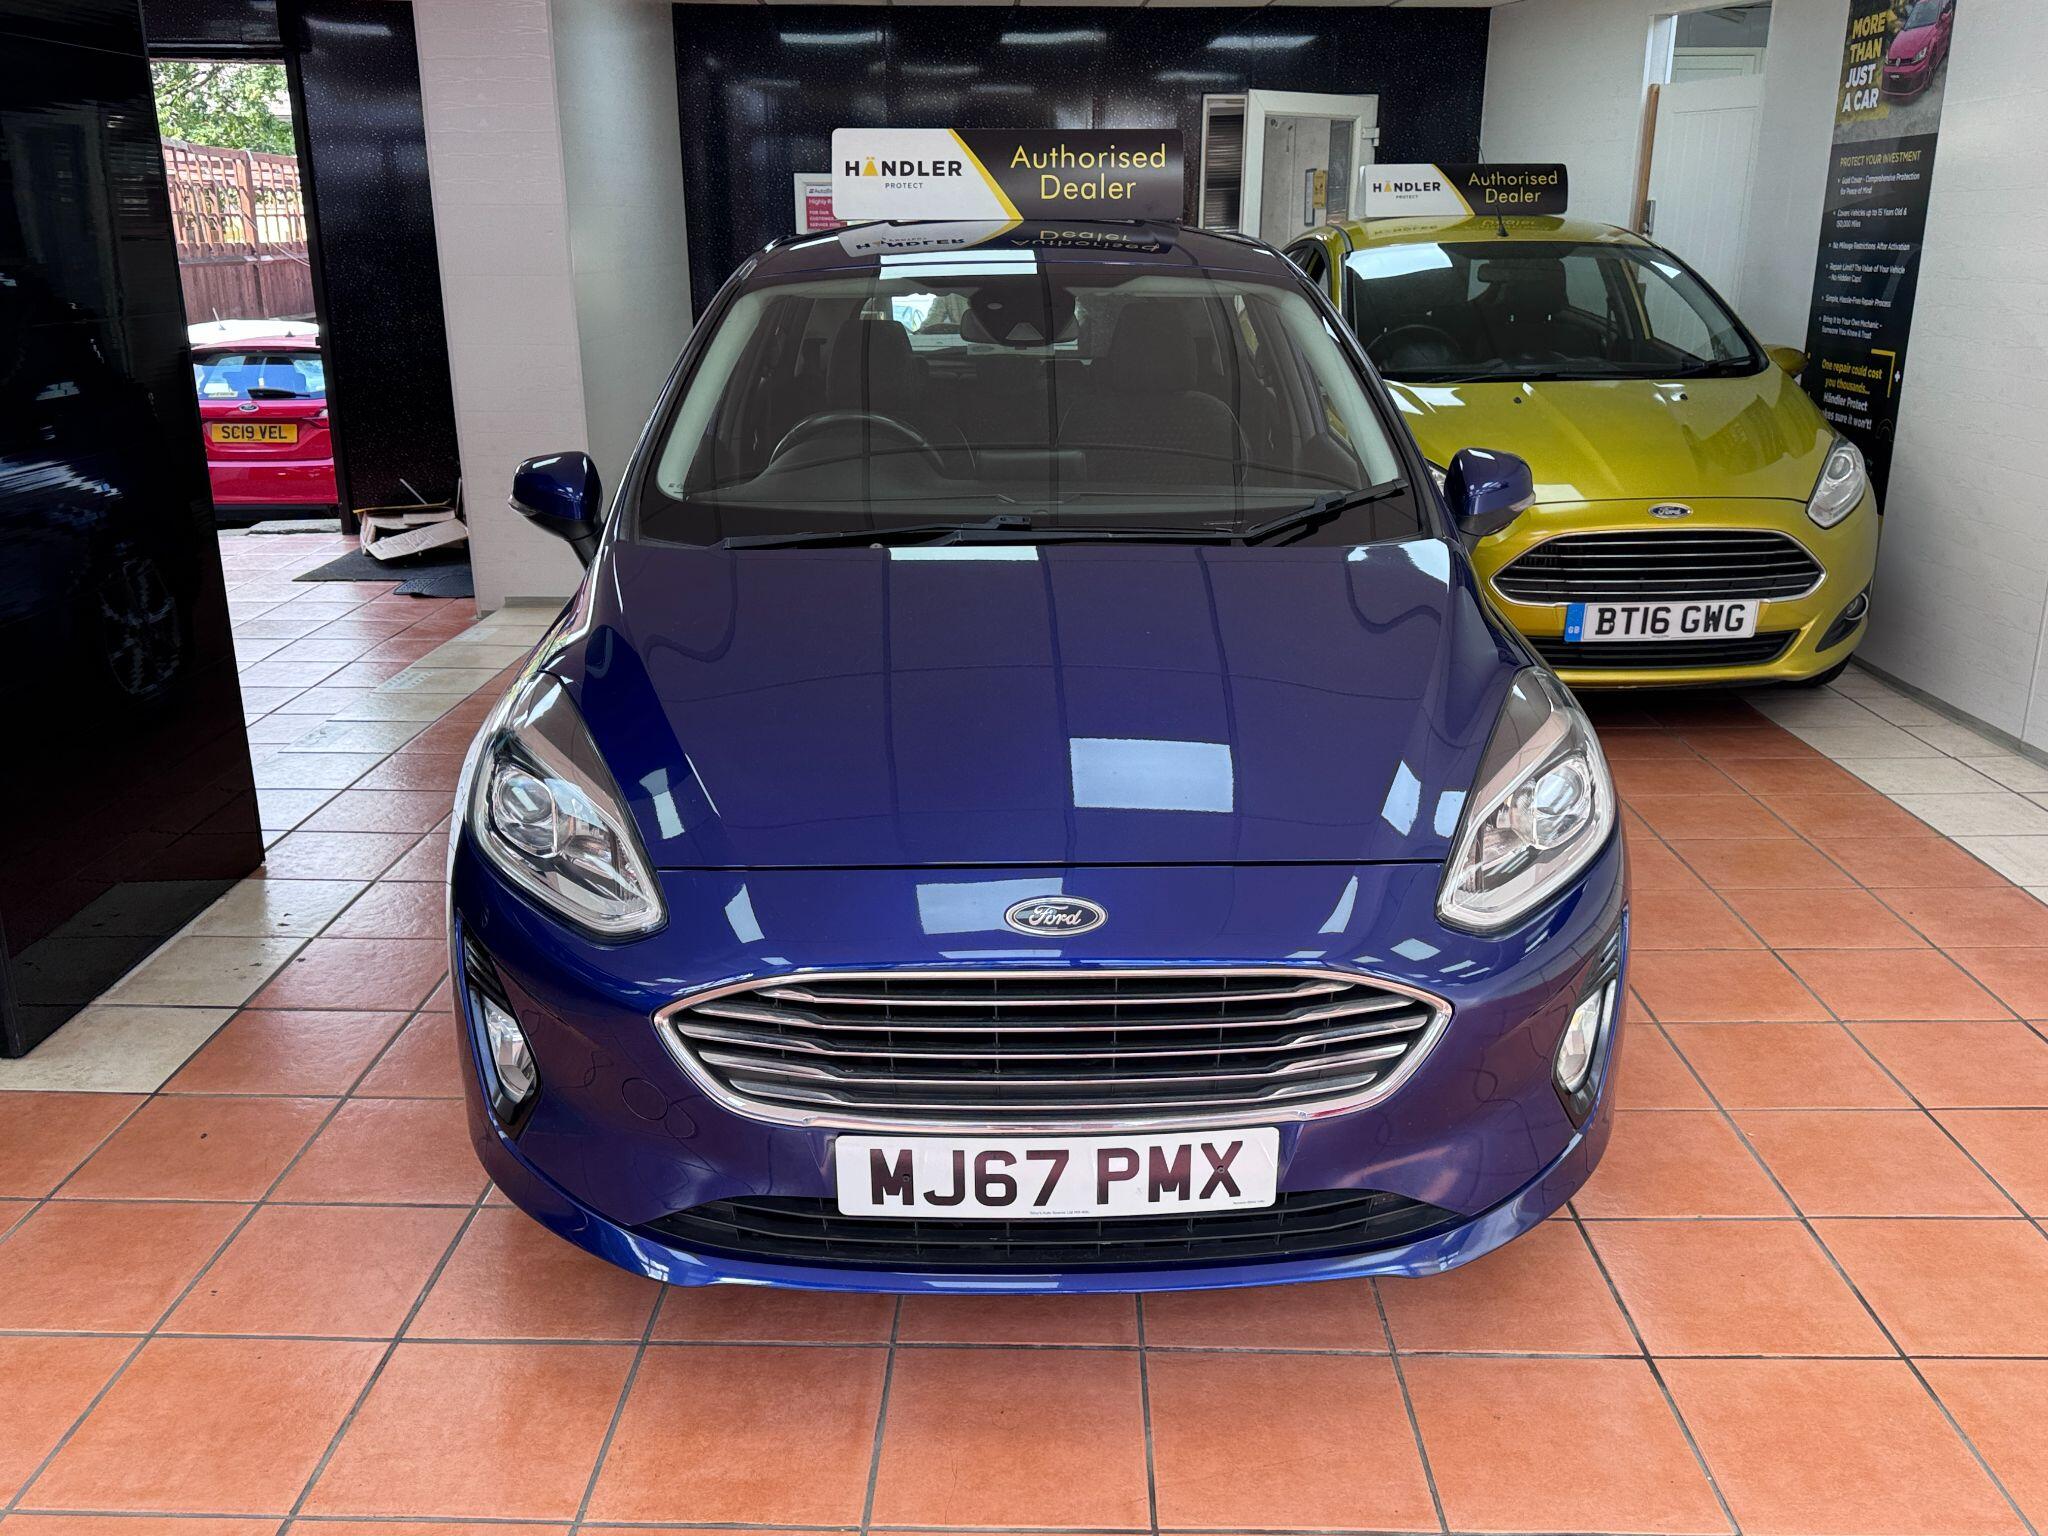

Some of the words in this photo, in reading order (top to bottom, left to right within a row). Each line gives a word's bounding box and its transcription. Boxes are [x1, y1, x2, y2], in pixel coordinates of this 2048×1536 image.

[1852, 12, 1887, 40] MORE
[1850, 38, 1882, 64] THAN
[1845, 64, 1876, 88] JUST
[1842, 96, 1852, 112] A
[1854, 88, 1879, 111] CAR
[845, 156, 962, 178] HÄNDLER
[1010, 144, 1166, 169] Authorised
[1840, 156, 1865, 167] PROTECT
[1865, 154, 1882, 165] YOUR
[1882, 150, 1921, 164] INVESTMENT
[1040, 174, 1136, 200] Dealer
[1468, 170, 1558, 186] Authorised
[1896, 172, 1920, 181] Protection
[1486, 188, 1542, 204] Dealer
[1822, 359, 1832, 370] One
[1833, 363, 1851, 374] repair
[1851, 365, 1867, 377] could
[1868, 368, 1883, 380] cost
[1825, 378, 1836, 388] you
[1847, 397, 1868, 412] Protect
[1835, 412, 1848, 423] sure
[1848, 414, 1852, 425] it
[221, 426, 254, 439] SC19
[259, 426, 288, 439] VEL
[1595, 606, 1670, 636] BT16
[1680, 603, 1746, 633] GWG
[1028, 905, 1082, 926] Ford
[869, 1148, 1070, 1207] MJ67
[1096, 1140, 1244, 1205] PMX
